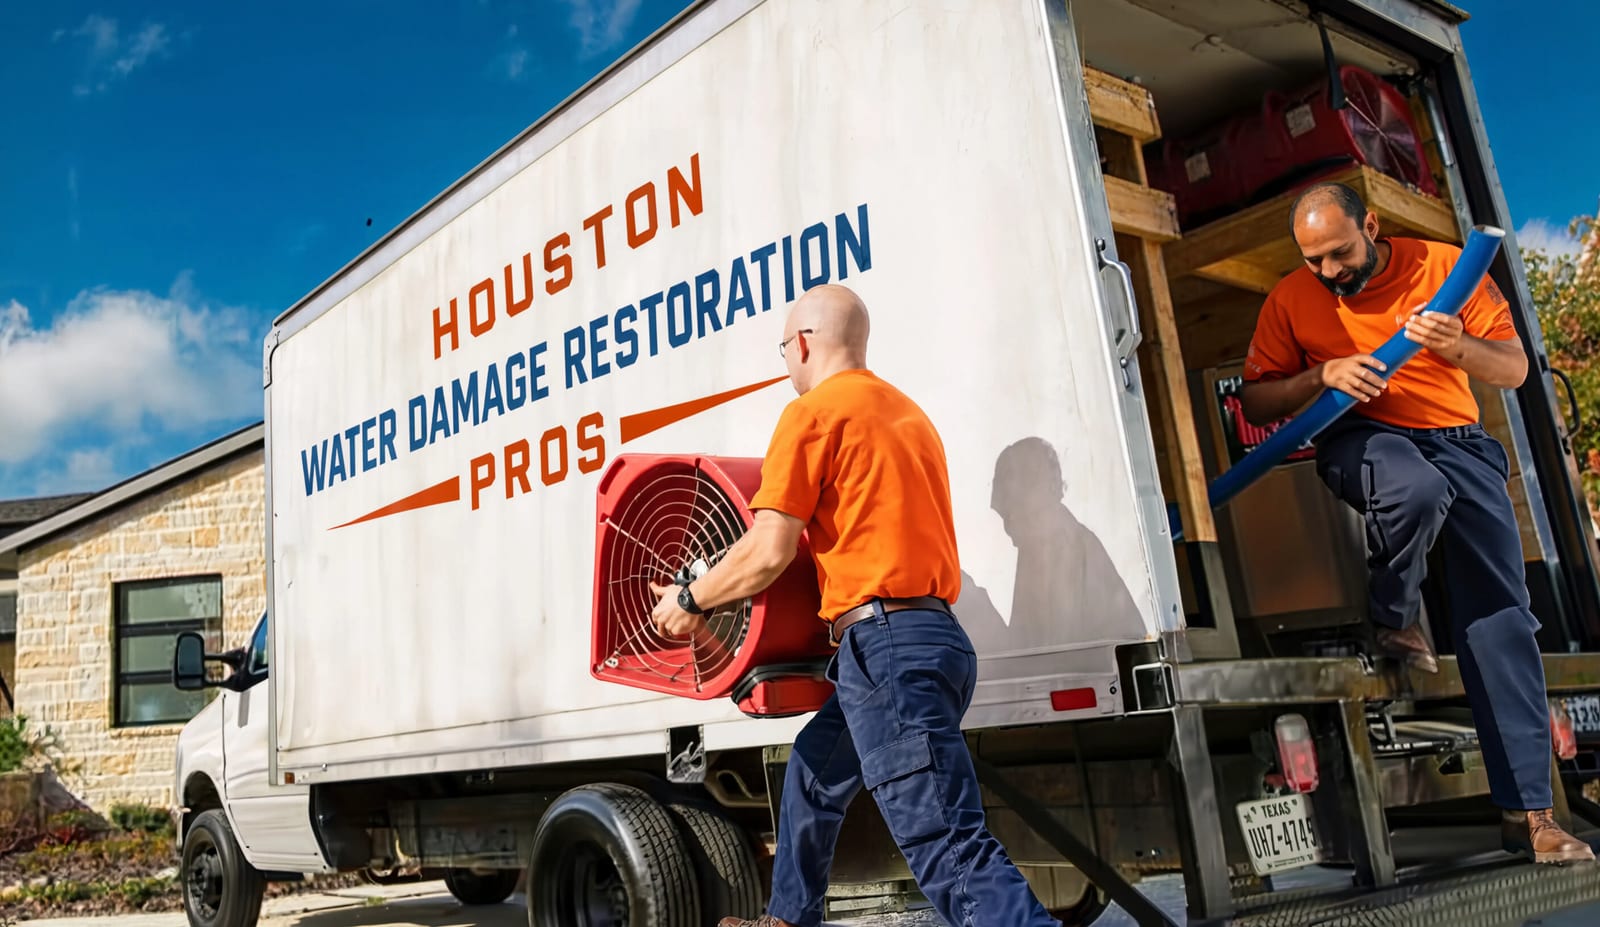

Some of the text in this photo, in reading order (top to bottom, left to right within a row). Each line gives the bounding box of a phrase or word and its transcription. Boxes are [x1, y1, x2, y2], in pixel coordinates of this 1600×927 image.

[432, 153, 703, 360] HOUSTON
[301, 204, 872, 496] WATER DAMAGE RESTORATION
[470, 411, 606, 511] PROS
[1261, 801, 1291, 818] TEXAS
